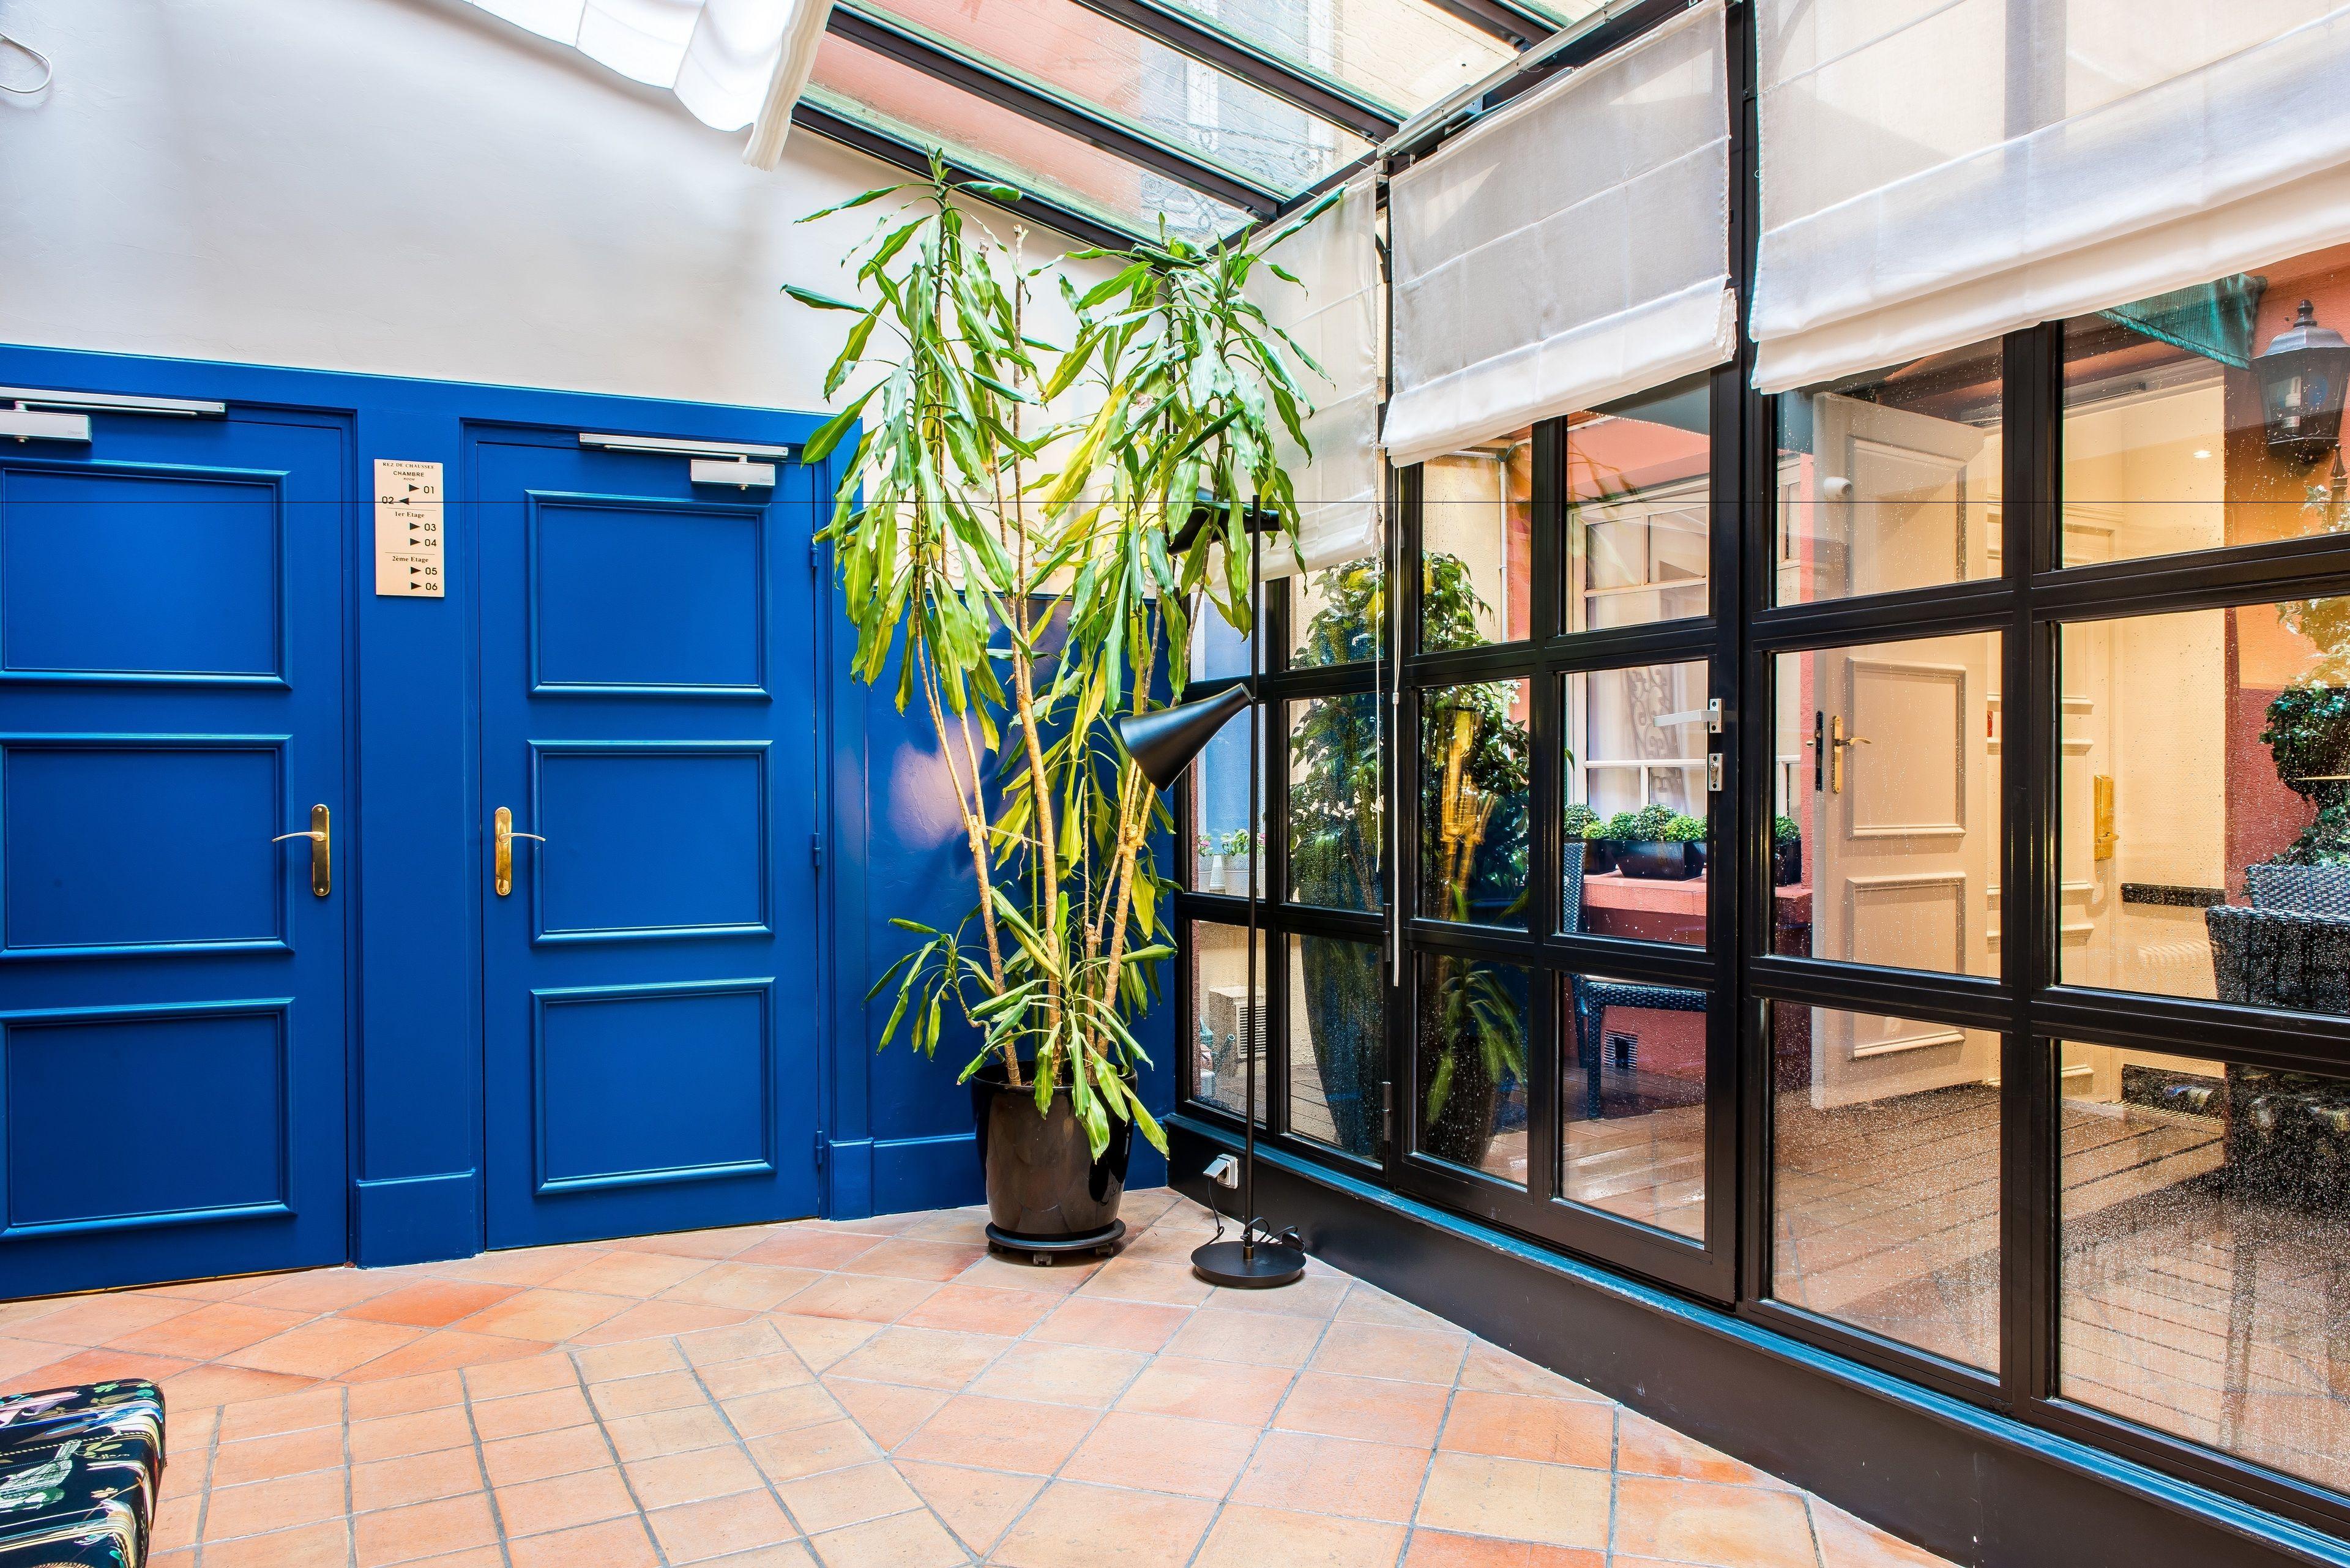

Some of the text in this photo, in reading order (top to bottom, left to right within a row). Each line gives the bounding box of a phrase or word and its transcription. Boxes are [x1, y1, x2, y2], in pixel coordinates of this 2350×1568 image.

[423, 485, 435, 494] 01
[381, 496, 395, 504] 02
[425, 567, 438, 575] 05
[425, 582, 438, 591] 06
